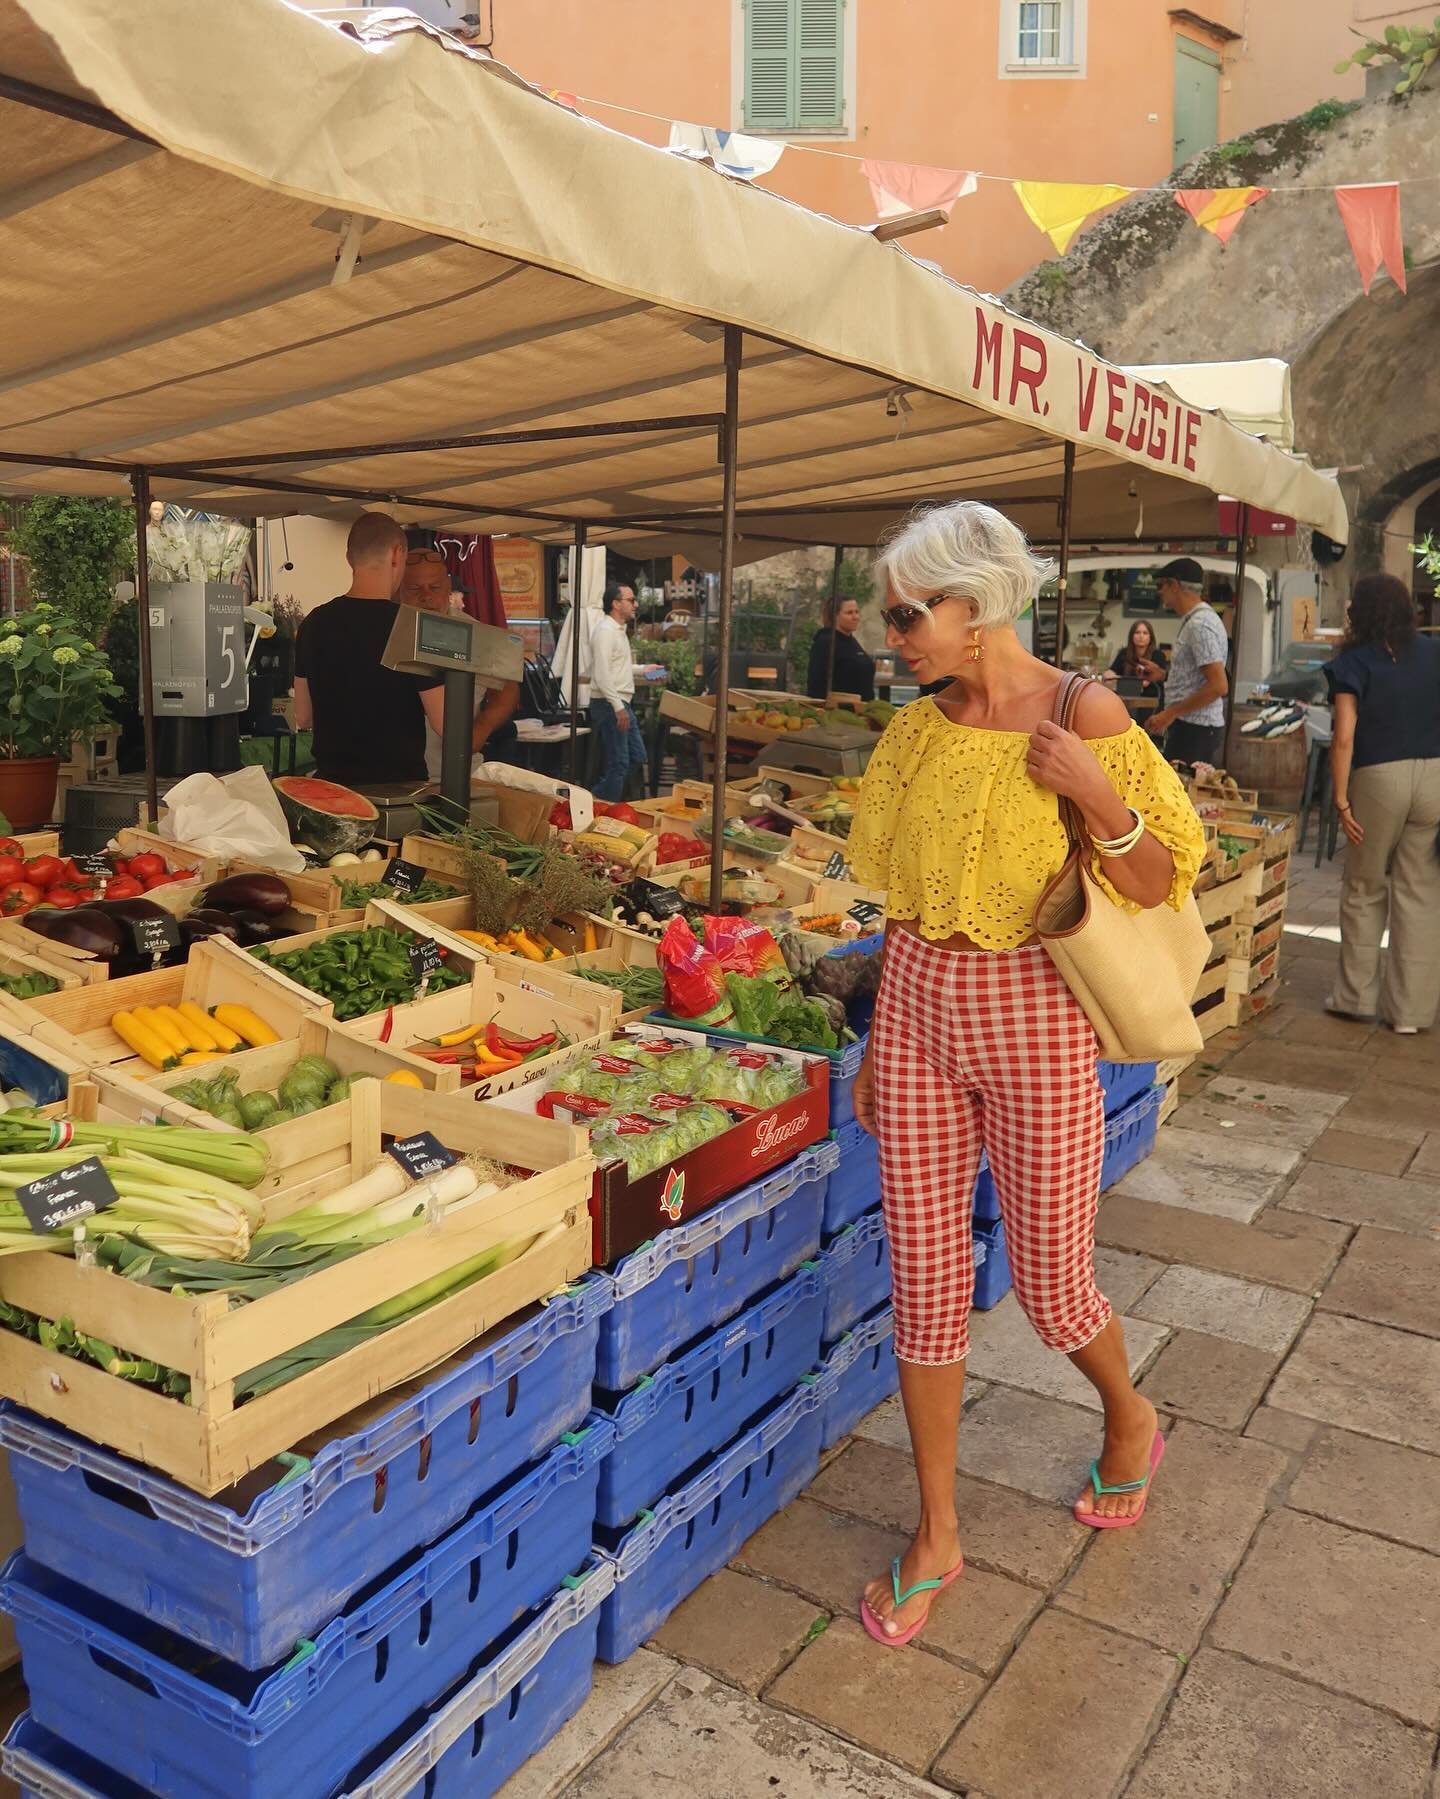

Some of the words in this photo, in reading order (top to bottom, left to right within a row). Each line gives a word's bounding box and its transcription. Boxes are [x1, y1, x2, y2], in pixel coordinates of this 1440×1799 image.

[972, 307, 1050, 417] MR.
[1078, 358, 1202, 472] VEGGIE
[151, 610, 160, 625] 5
[220, 625, 235, 689] 5
[152, 681, 196, 689] HALAENOPSIS
